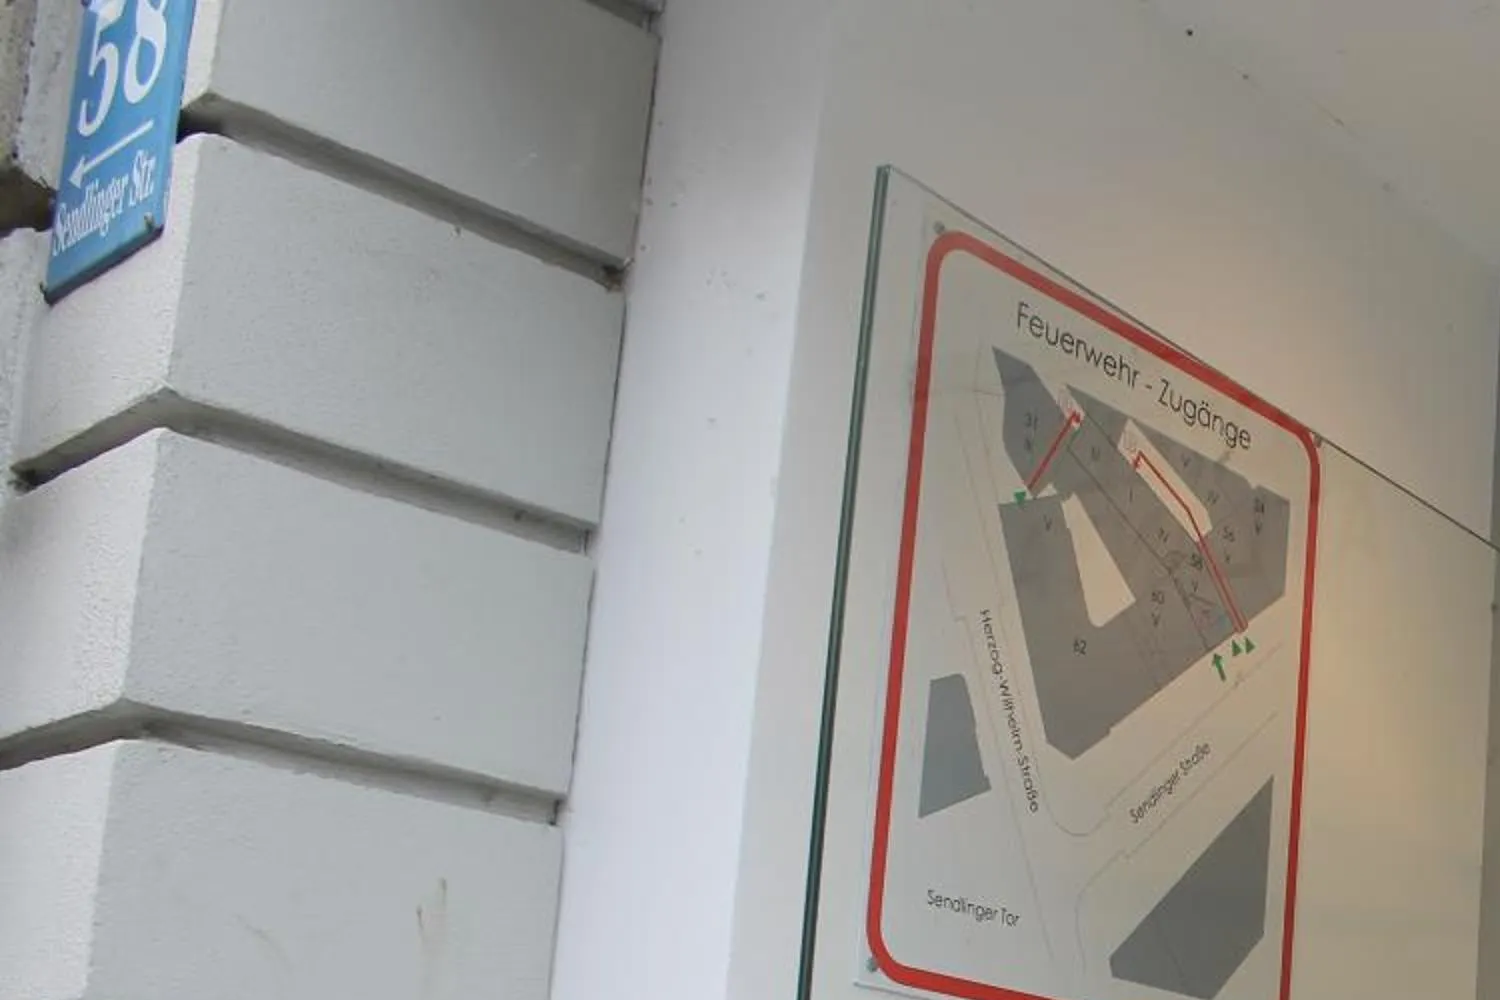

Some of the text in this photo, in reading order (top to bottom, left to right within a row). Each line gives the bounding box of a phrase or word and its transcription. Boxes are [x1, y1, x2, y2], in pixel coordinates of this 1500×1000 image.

[78, 0, 168, 136] 58
[52, 172, 128, 256] Sendlinger
[1017, 301, 1140, 390] Feuerwehr
[1157, 378, 1251, 450] Zugänge
[927, 890, 1020, 928] Sendlinger Tor
